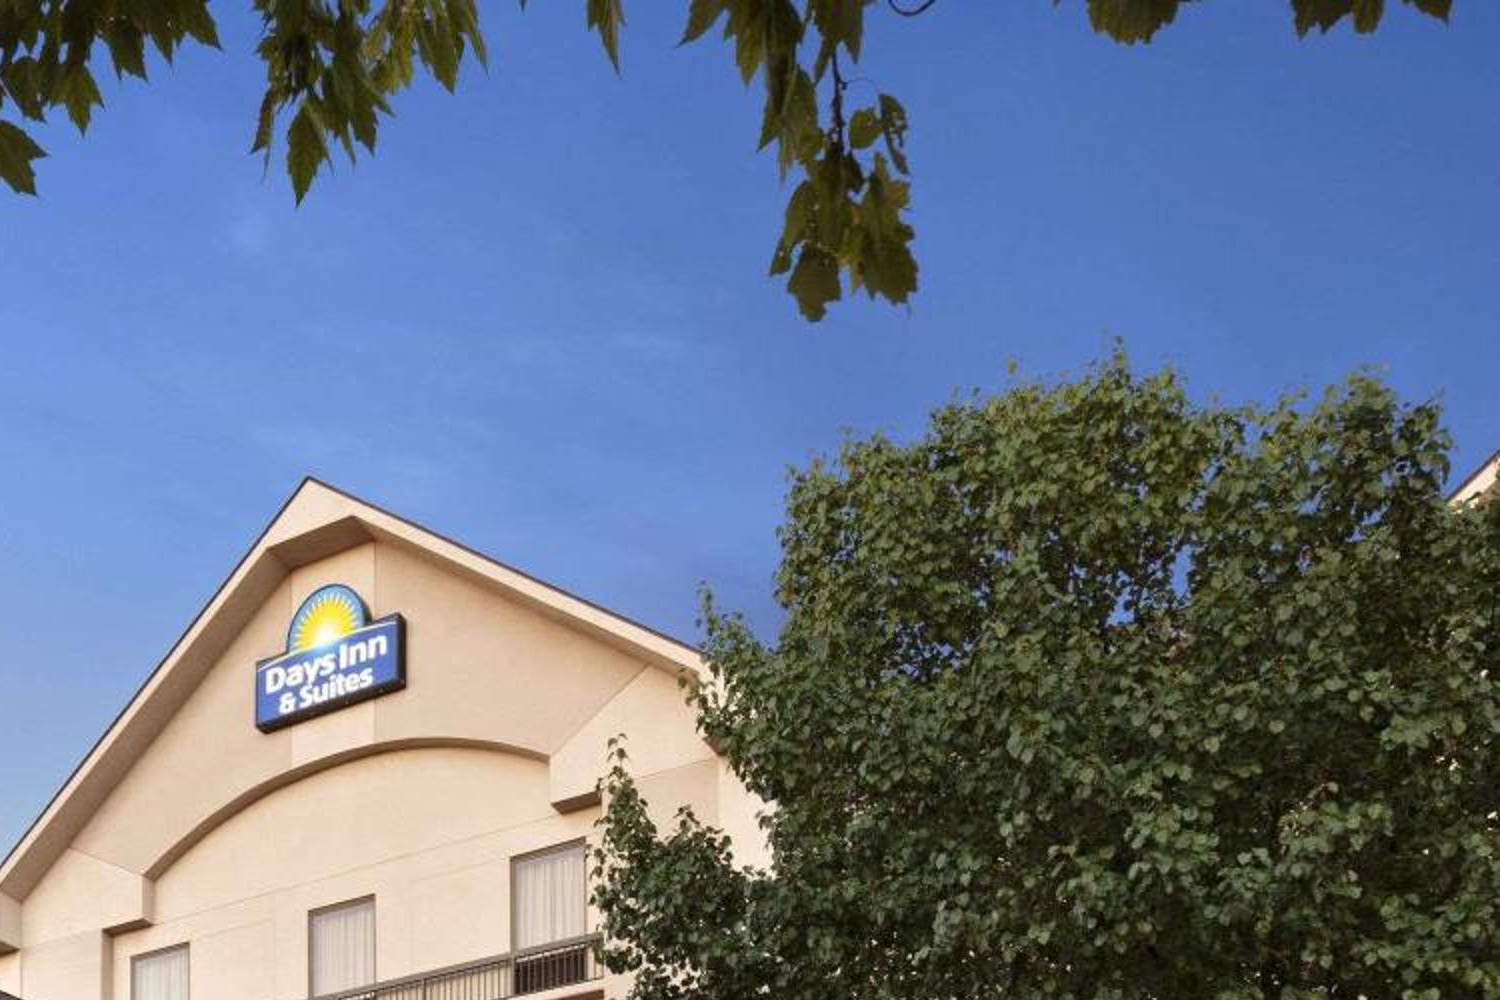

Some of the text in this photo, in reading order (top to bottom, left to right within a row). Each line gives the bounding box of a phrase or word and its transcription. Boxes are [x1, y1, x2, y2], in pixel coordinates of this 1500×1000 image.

[265, 634, 388, 694] Days Inn
[279, 669, 374, 714] & Suites
